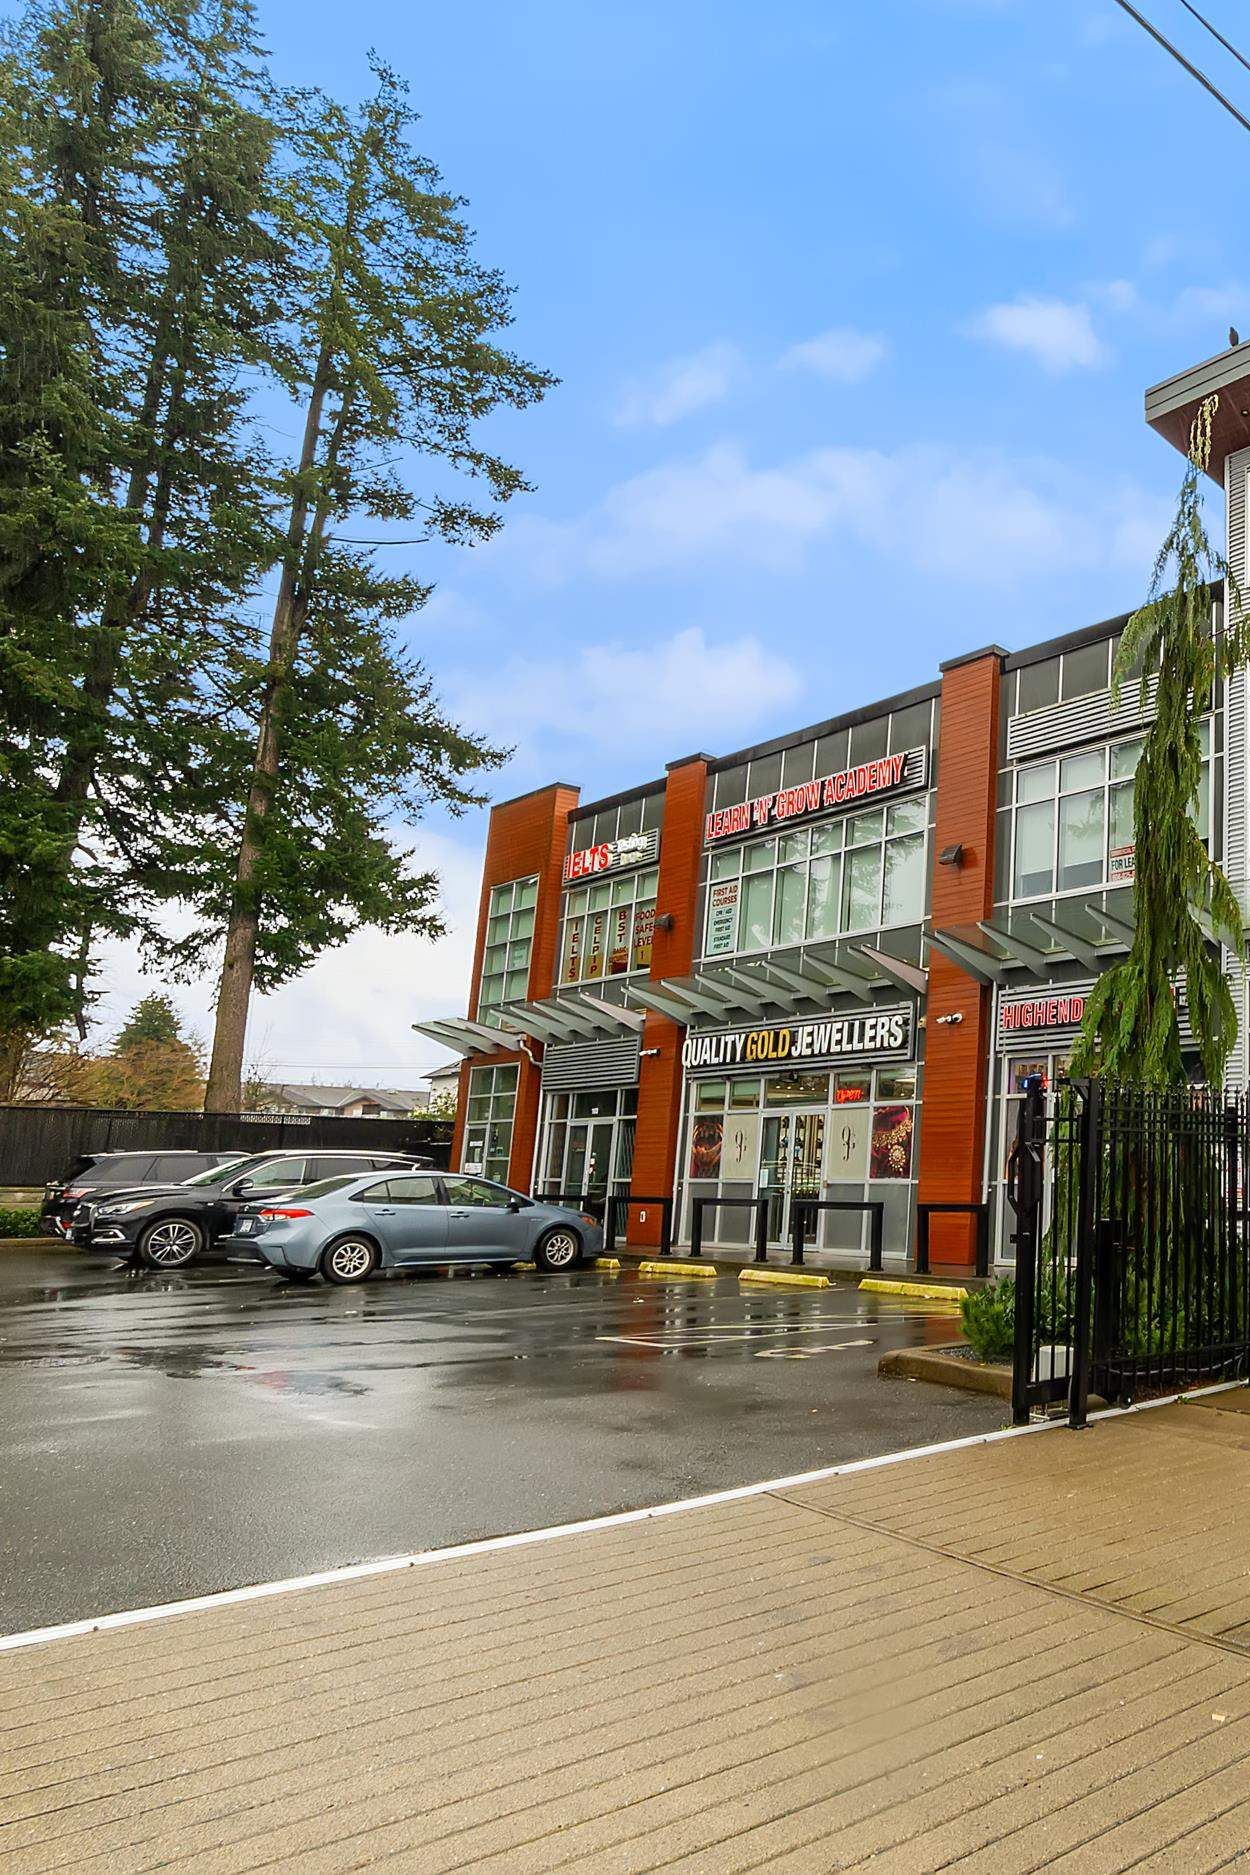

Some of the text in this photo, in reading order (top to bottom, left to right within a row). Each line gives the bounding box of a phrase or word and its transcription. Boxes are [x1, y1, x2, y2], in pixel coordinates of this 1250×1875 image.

[706, 802, 750, 840] LEARN
[776, 781, 821, 819] GROW
[823, 753, 905, 805] ACADEMY
[566, 842, 610, 879] IELTS
[713, 885, 738, 896] FIRST AID
[713, 895, 737, 906] COURSES
[617, 910, 627, 943] BST
[635, 908, 656, 920] FOOD
[568, 921, 579, 980] IELTS
[590, 916, 602, 974] CELPIP
[634, 936, 653, 948] LEVE
[1002, 997, 1085, 1029] HIGHEND
[681, 1015, 903, 1068] QUALITY GOLD JEWELLERS
